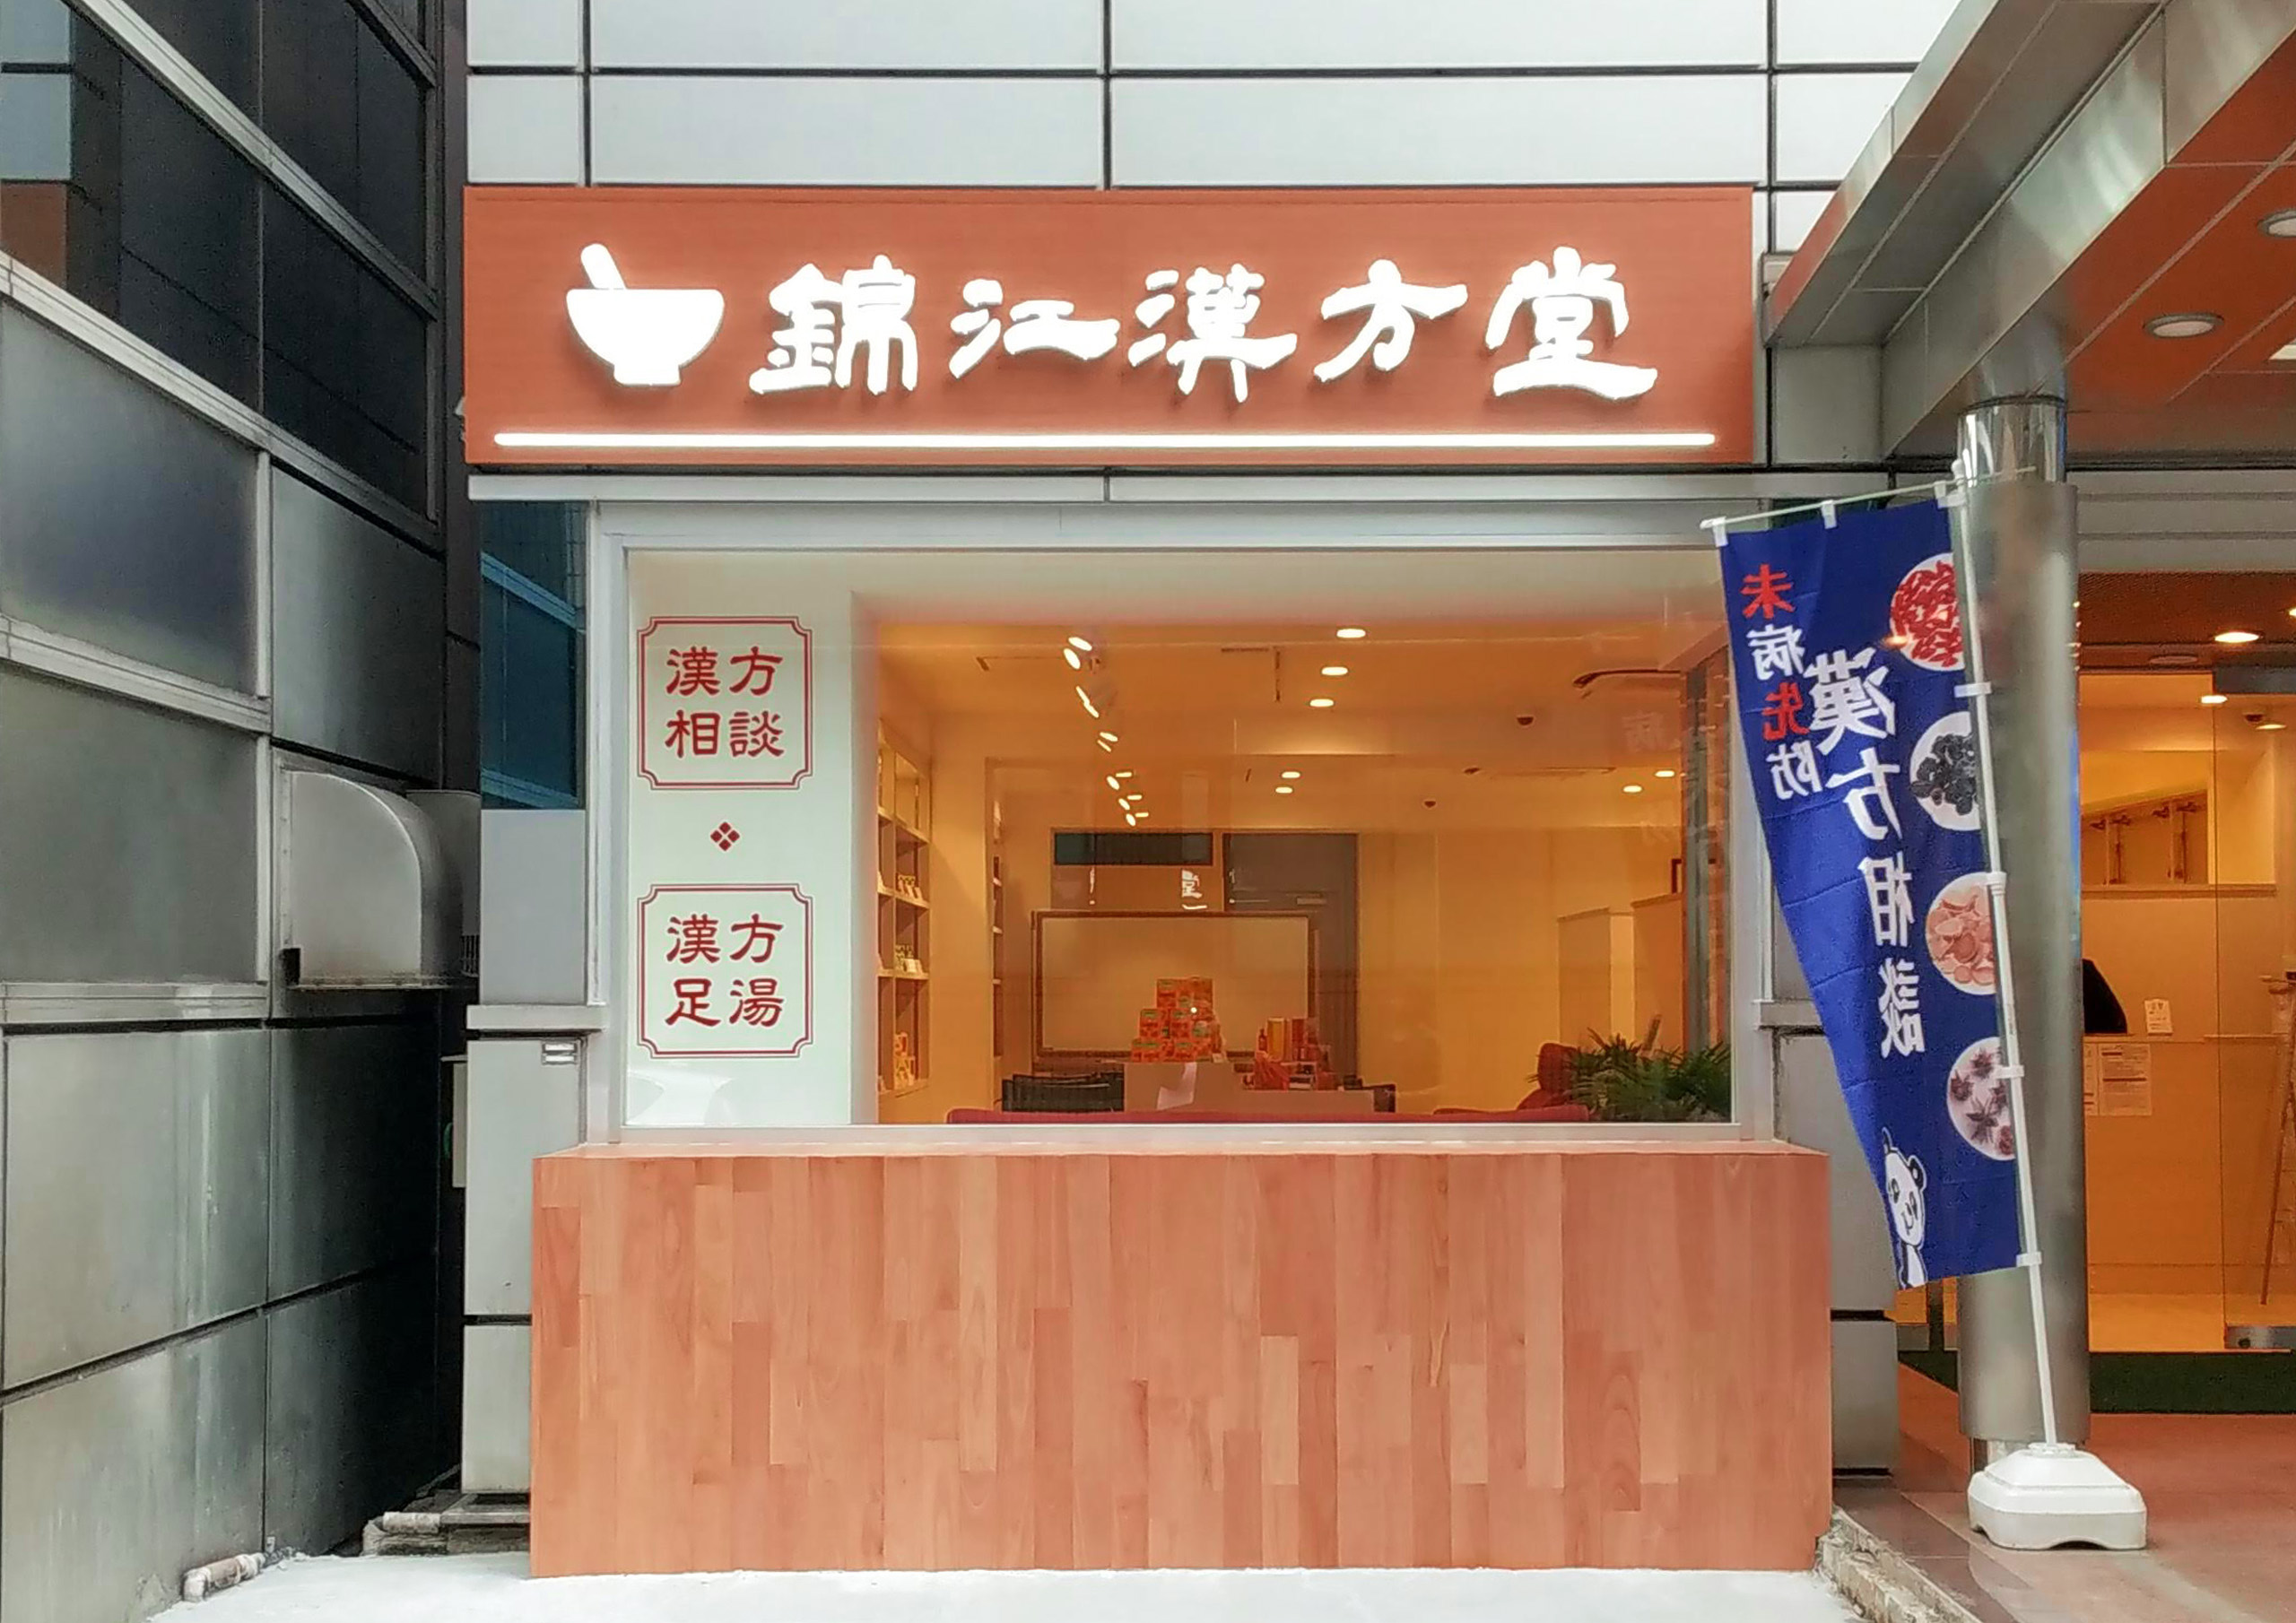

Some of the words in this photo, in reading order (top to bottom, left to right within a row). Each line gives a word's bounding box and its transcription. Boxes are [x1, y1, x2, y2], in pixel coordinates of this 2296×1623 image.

[749, 246, 1658, 403] 錦江漢方堂
[665, 646, 784, 697] 漢方
[665, 708, 784, 758] 相談
[665, 913, 784, 964] 漢方
[665, 976, 784, 1028] 足湯
